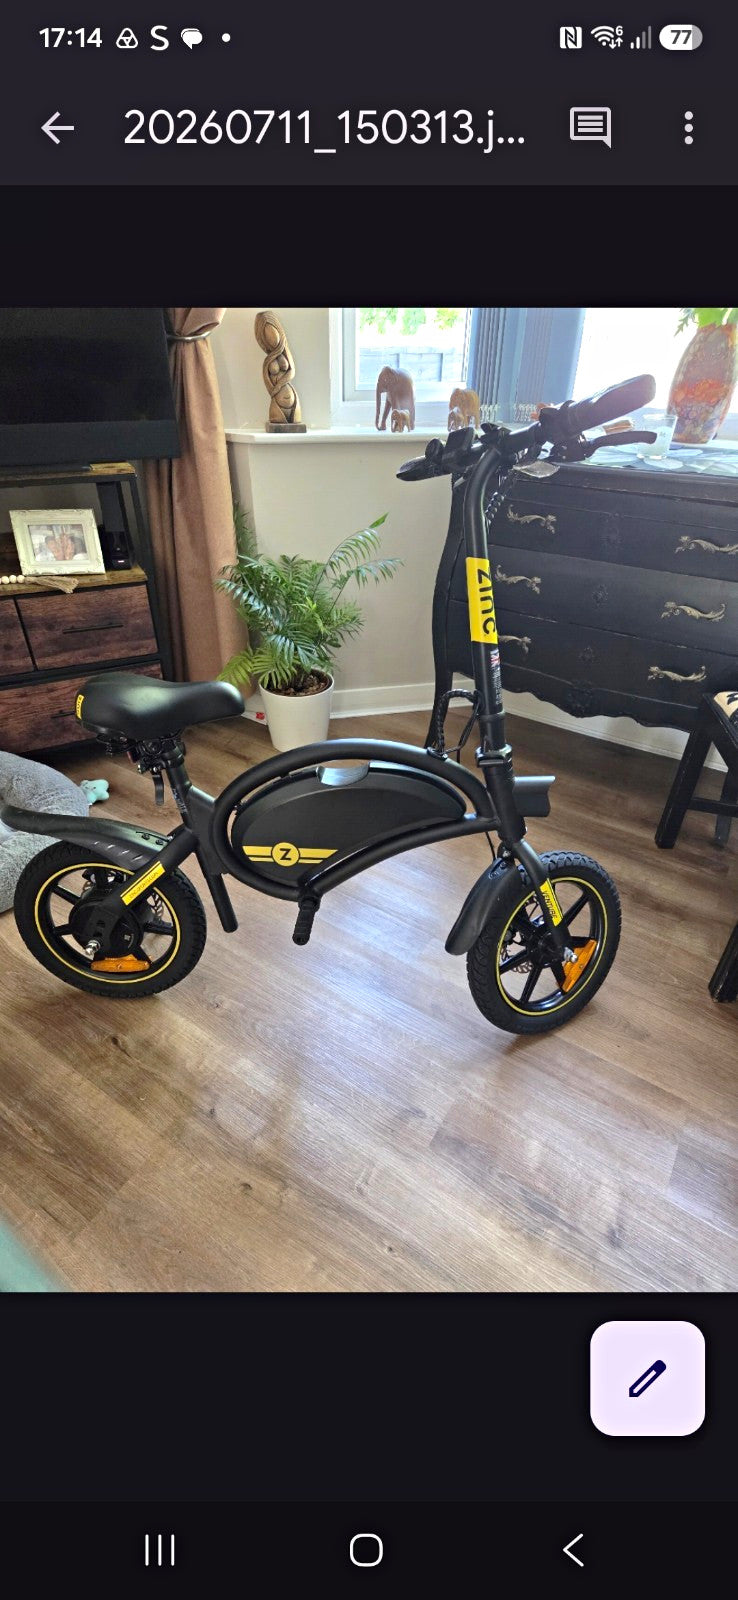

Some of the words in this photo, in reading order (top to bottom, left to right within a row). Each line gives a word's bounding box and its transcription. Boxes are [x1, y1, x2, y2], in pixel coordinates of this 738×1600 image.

[39, 28, 102, 47] 17:14
[670, 29, 692, 45] 77
[124, 110, 525, 153] 20260711_150313.j...
[477, 568, 497, 635] zinc
[279, 848, 292, 861] Z
